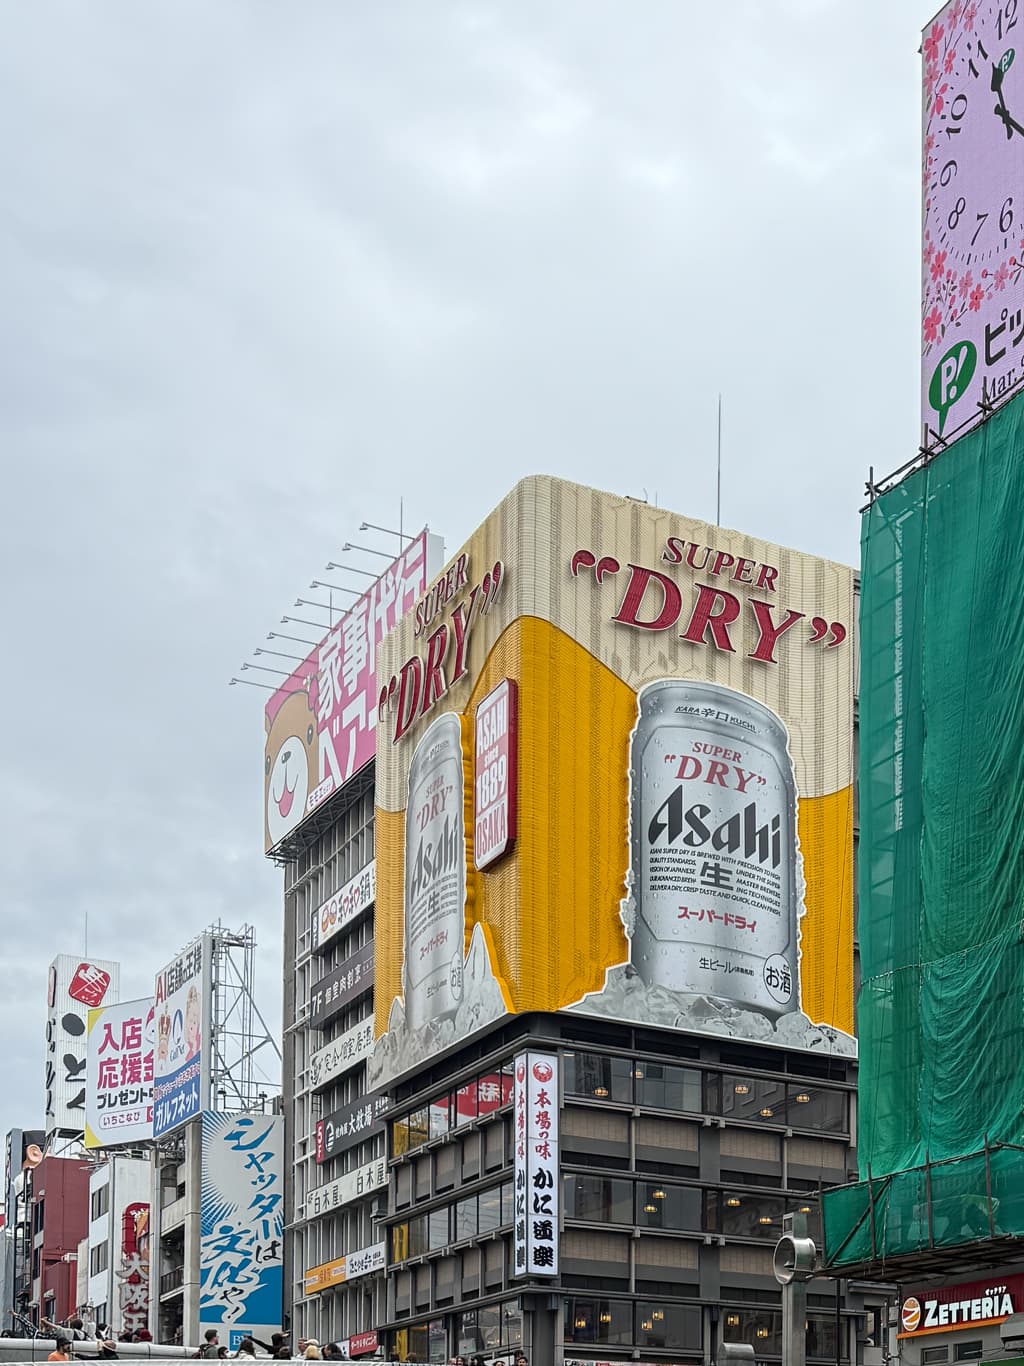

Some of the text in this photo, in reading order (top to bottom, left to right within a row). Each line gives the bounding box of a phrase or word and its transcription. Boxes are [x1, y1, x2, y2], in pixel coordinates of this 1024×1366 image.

[967, 39, 989, 79] 11
[945, 94, 968, 140] 10
[939, 159, 958, 188] 9
[948, 197, 966, 230] 8
[971, 212, 989, 246] 7
[999, 197, 1014, 233] 6
[661, 536, 780, 594] SUPER
[414, 552, 469, 640] SUPER
[318, 537, 424, 723] 家事代行
[476, 694, 507, 756] ASAHI
[675, 705, 700, 715] KARA
[729, 716, 757, 732] KUCHI
[692, 742, 742, 763] SUPER
[476, 753, 507, 814] 1889
[476, 802, 506, 860] OSAKA
[647, 784, 781, 869] Asahi
[410, 812, 458, 905] Asahi
[663, 848, 678, 856] SUPER
[697, 851, 720, 861] BREWED
[737, 860, 764, 873] PRECISION
[699, 861, 734, 891] 生
[427, 890, 440, 919] 生
[677, 906, 757, 933] スーパードライ
[699, 957, 736, 974] 生ビール
[311, 990, 323, 1017] 7F
[98, 1017, 142, 1055] 入店
[156, 1082, 198, 1132] ガルフネット
[533, 1087, 552, 1161] 本場の味
[313, 1163, 384, 1214] 白木屋 白木屋
[923, 1293, 1014, 1328] ZETTERIA
